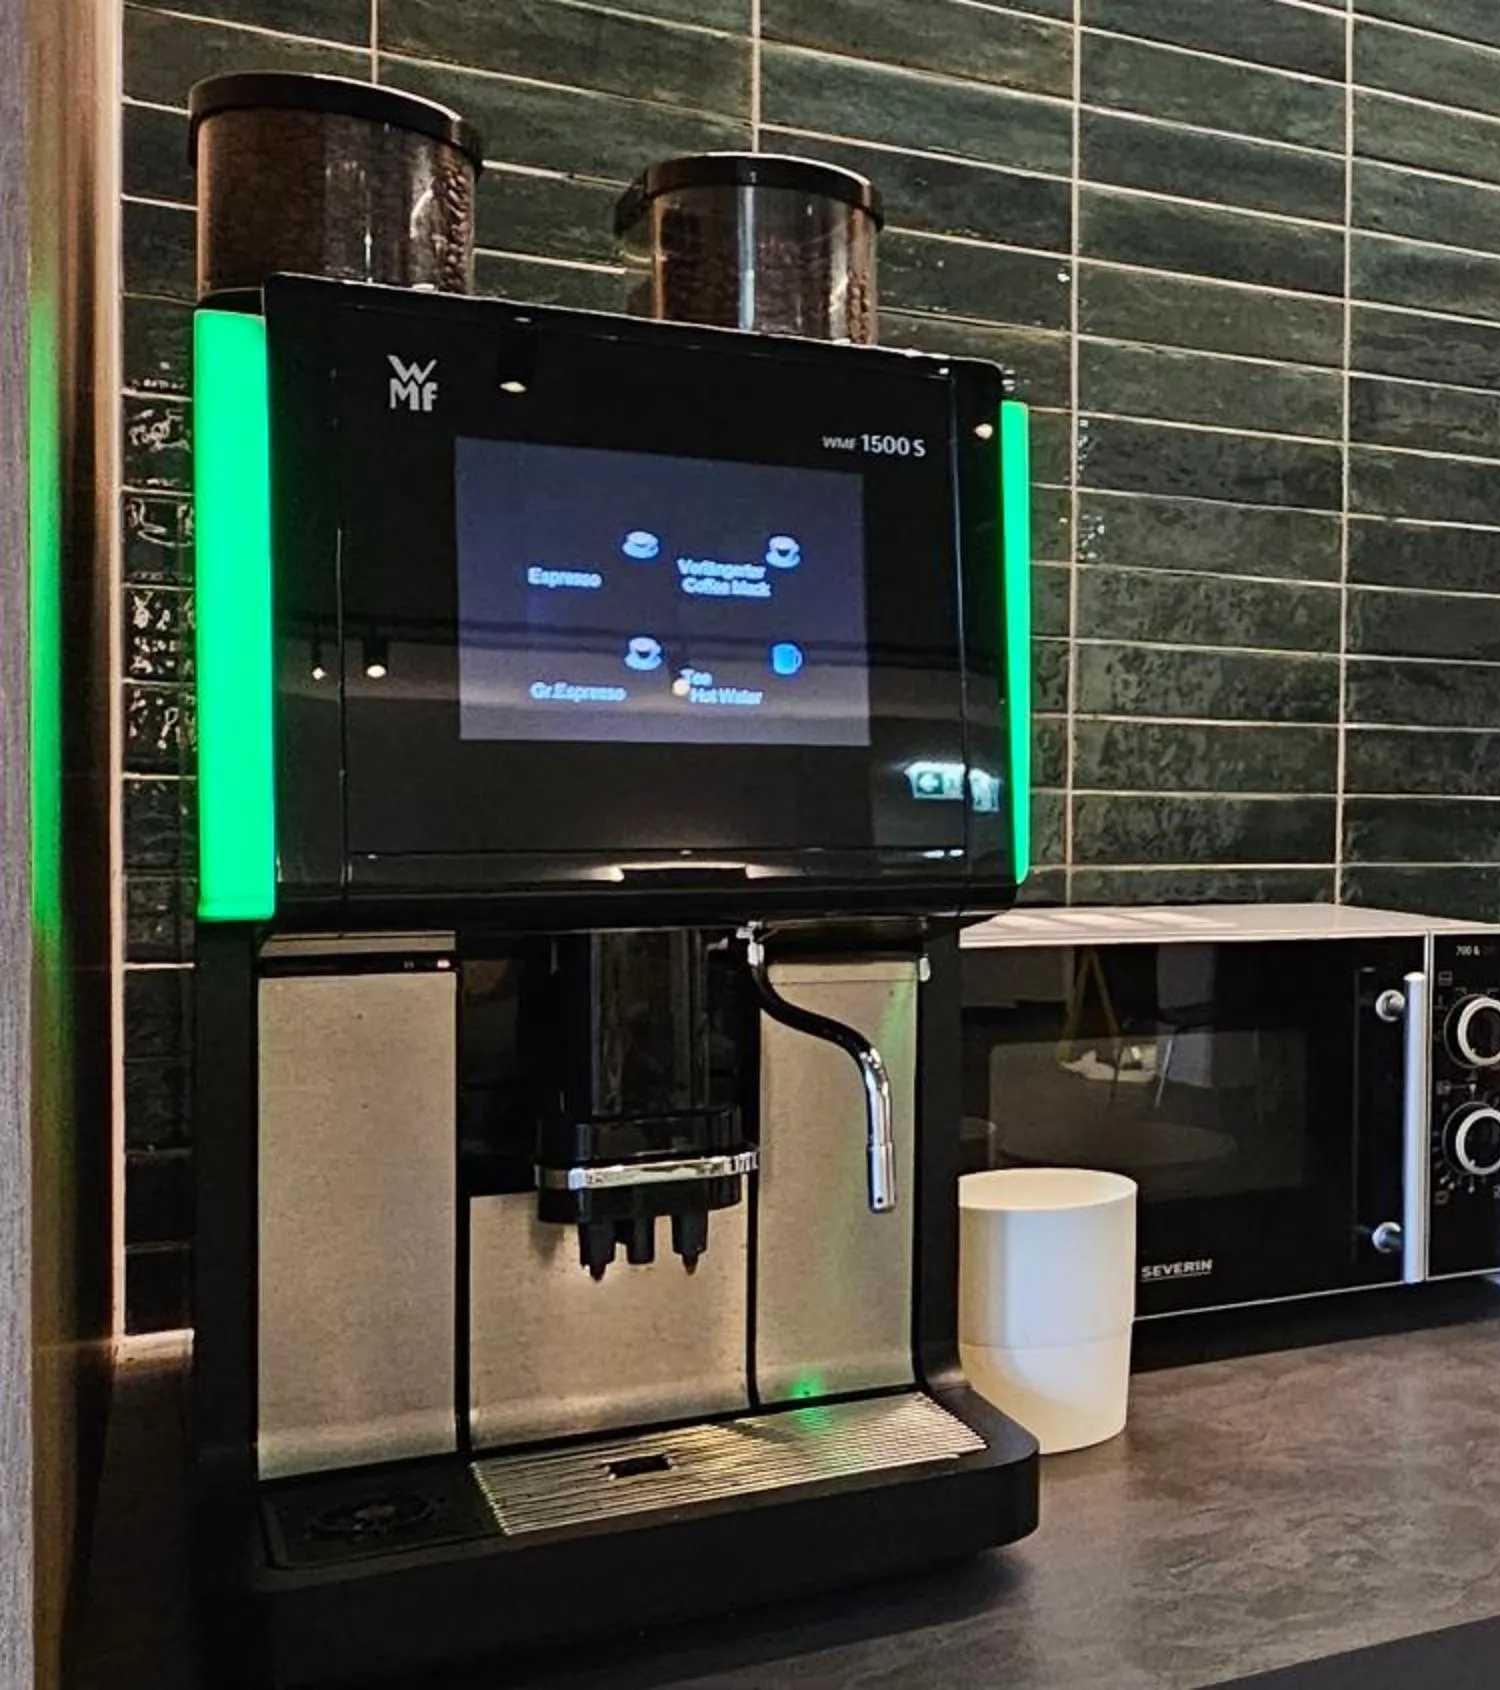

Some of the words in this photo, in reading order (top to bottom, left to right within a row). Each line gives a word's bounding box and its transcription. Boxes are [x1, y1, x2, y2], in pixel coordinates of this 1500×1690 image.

[386, 353, 439, 412] WMF
[821, 435, 857, 451] WMF
[860, 433, 911, 457] 1500
[912, 438, 927, 457] S
[527, 566, 603, 588] Espresso
[690, 687, 718, 704] Hot
[1140, 1257, 1214, 1278] SEVERIN
